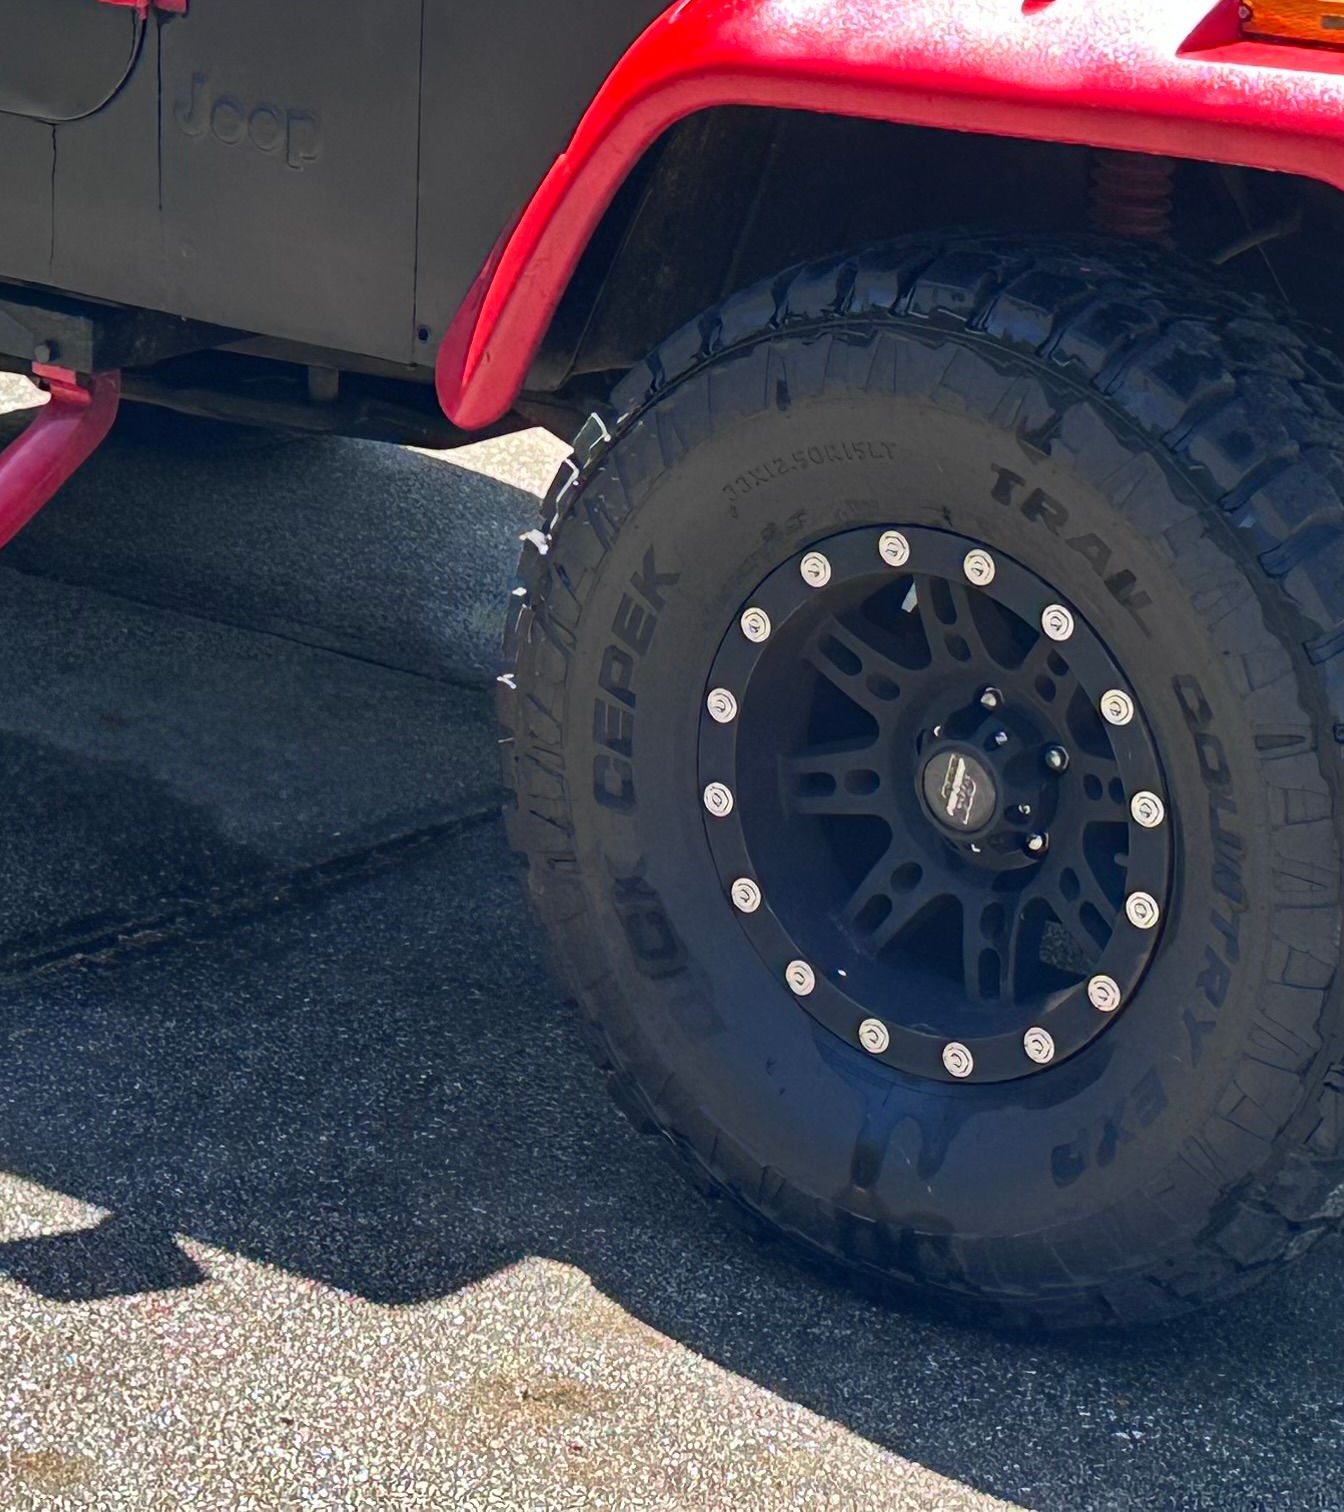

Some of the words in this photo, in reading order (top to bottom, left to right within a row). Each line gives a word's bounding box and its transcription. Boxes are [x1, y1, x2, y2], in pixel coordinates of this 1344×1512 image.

[173, 71, 323, 171] Jeep
[592, 544, 681, 811] CEPEK
[989, 461, 1154, 639] TRAIL
[1171, 673, 1250, 1068] COUNTRY
